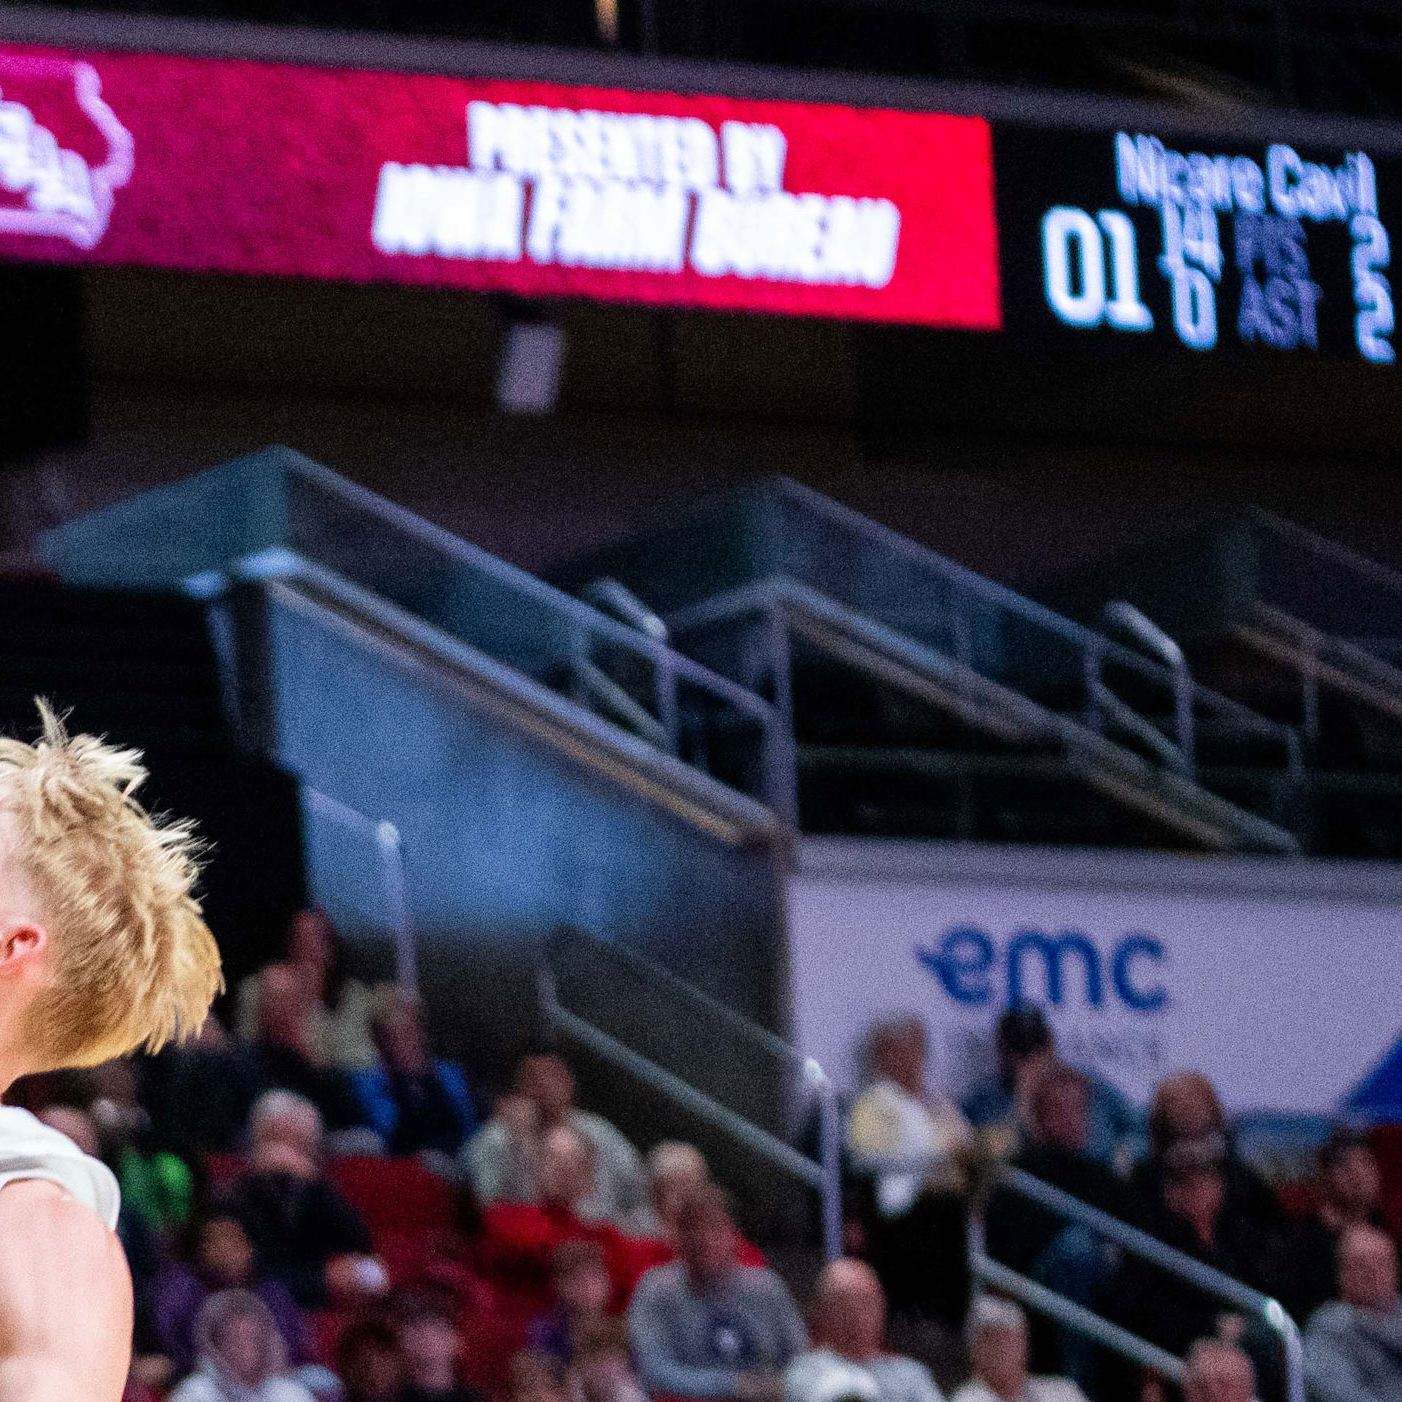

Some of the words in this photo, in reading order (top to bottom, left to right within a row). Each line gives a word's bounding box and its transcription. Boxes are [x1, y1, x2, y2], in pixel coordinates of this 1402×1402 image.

[466, 100, 720, 195] PRESENTED
[721, 118, 788, 197] BY
[371, 162, 523, 263] IOWA
[525, 172, 685, 274] FARM
[689, 188, 902, 290] BUREAU
[1041, 205, 1154, 333] 01
[916, 924, 1168, 1012] emc
